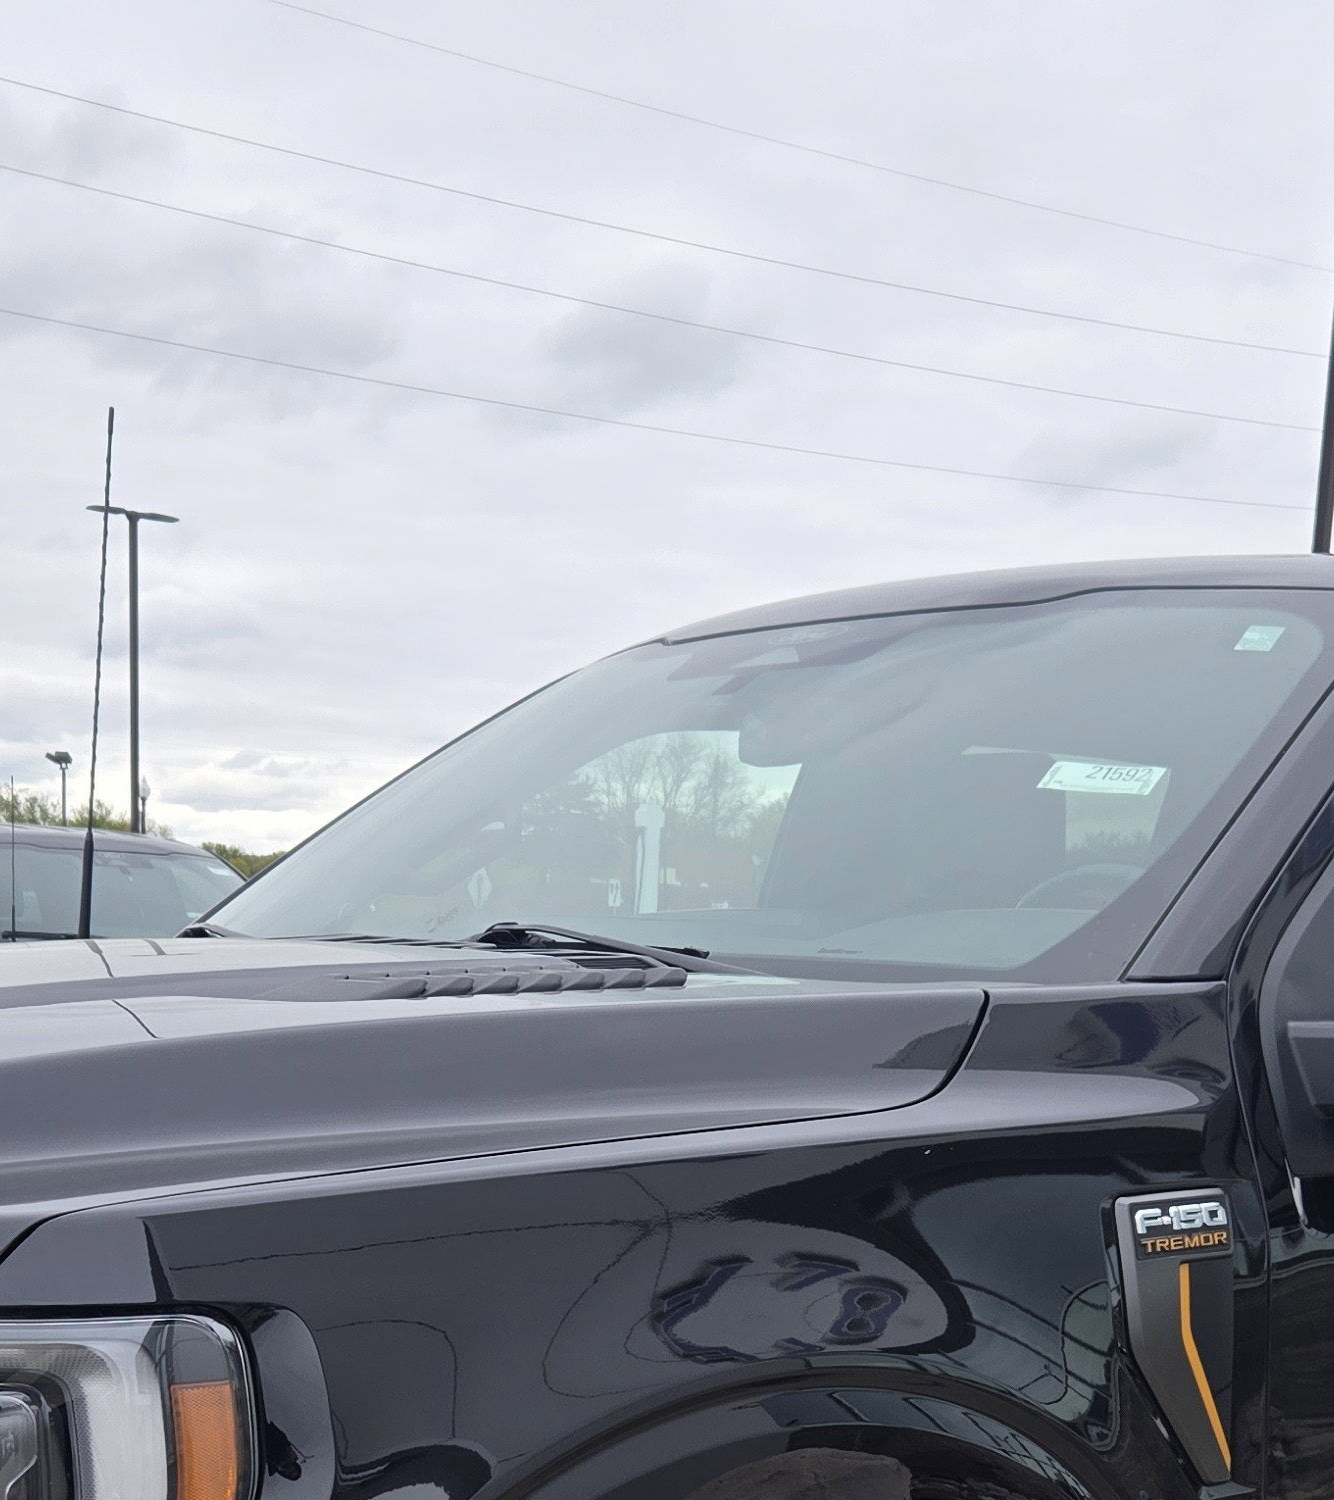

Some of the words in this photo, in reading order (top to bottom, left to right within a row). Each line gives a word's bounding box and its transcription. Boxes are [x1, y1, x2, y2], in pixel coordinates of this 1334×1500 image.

[1085, 766, 1154, 782] 21592
[1135, 1202, 1227, 1234] F-150
[1141, 1231, 1227, 1253] TREMOR
